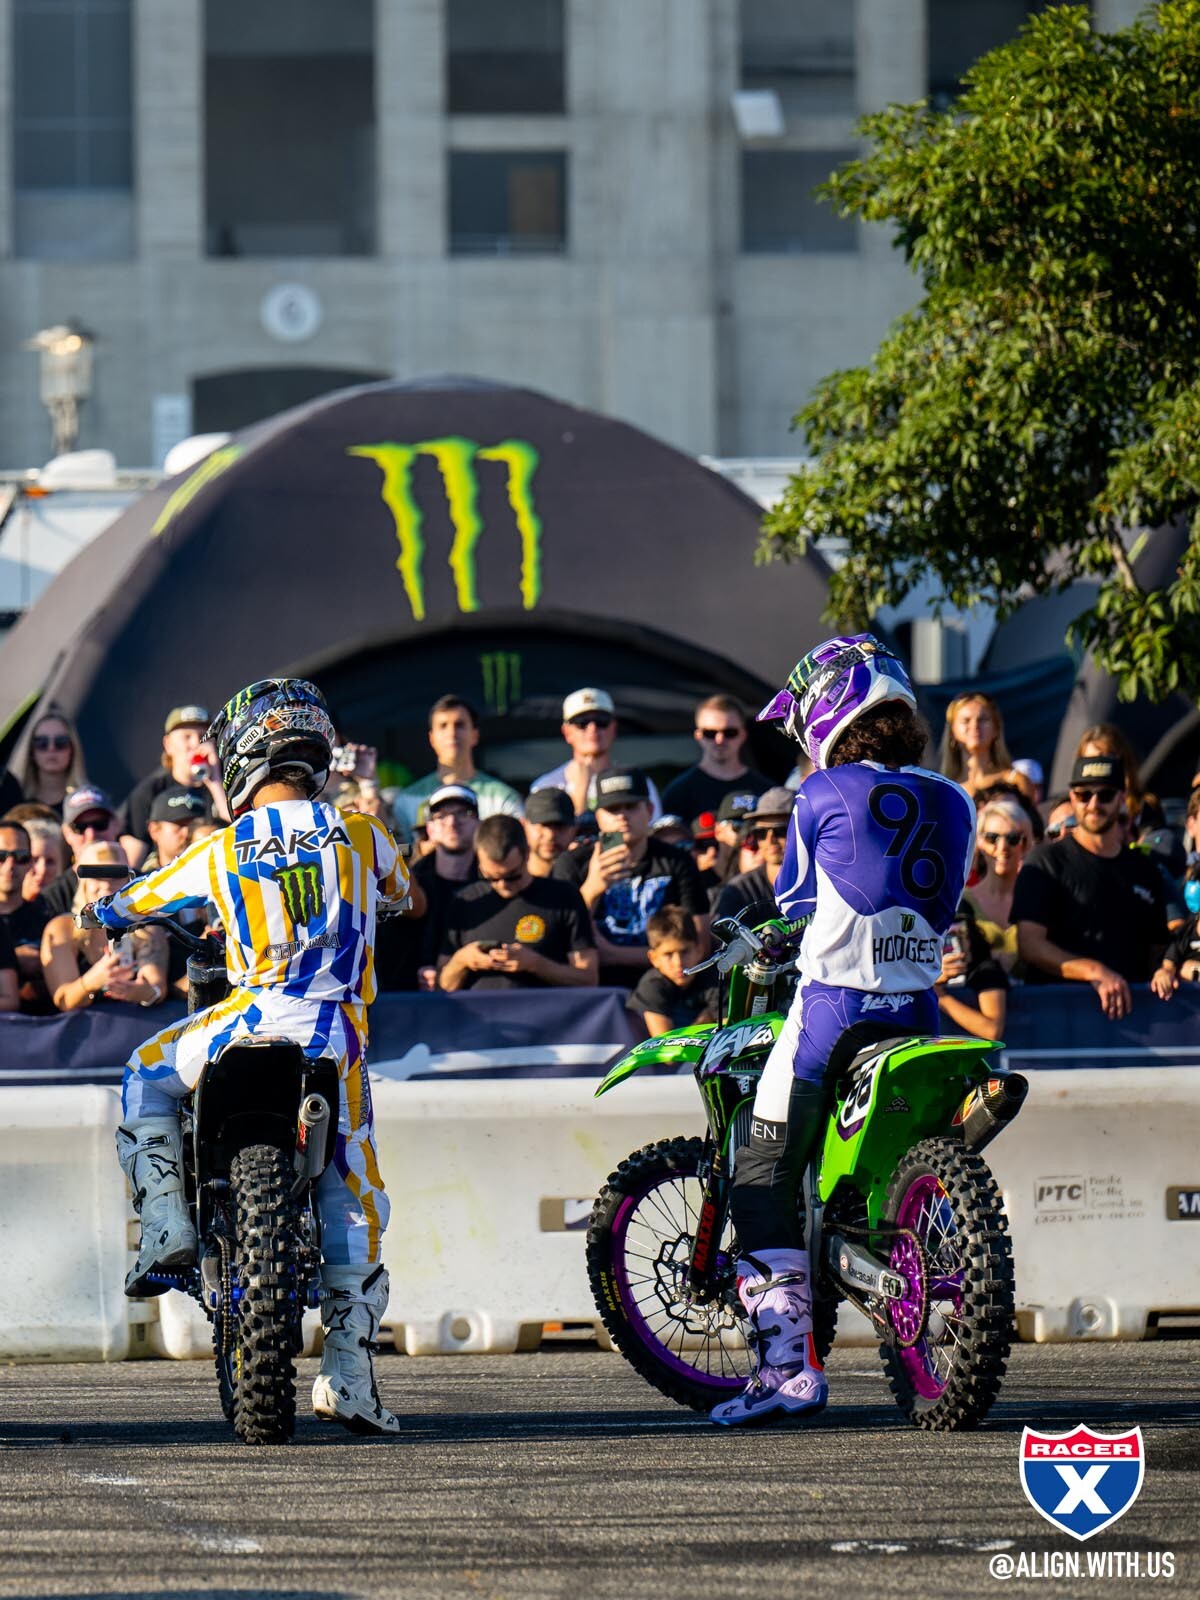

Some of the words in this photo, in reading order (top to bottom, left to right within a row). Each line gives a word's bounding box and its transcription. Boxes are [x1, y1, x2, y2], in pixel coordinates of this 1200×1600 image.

[828, 678, 850, 702] BELL
[239, 729, 260, 750] SHOEI
[234, 826, 352, 864] TAKA
[867, 783, 947, 900] 96
[873, 935, 938, 964] HODGES
[665, 1038, 709, 1049] CIRCU
[1038, 1184, 1082, 1202] PTC
[693, 1202, 716, 1272] MAXXIS
[600, 1271, 616, 1311] MAXXIS
